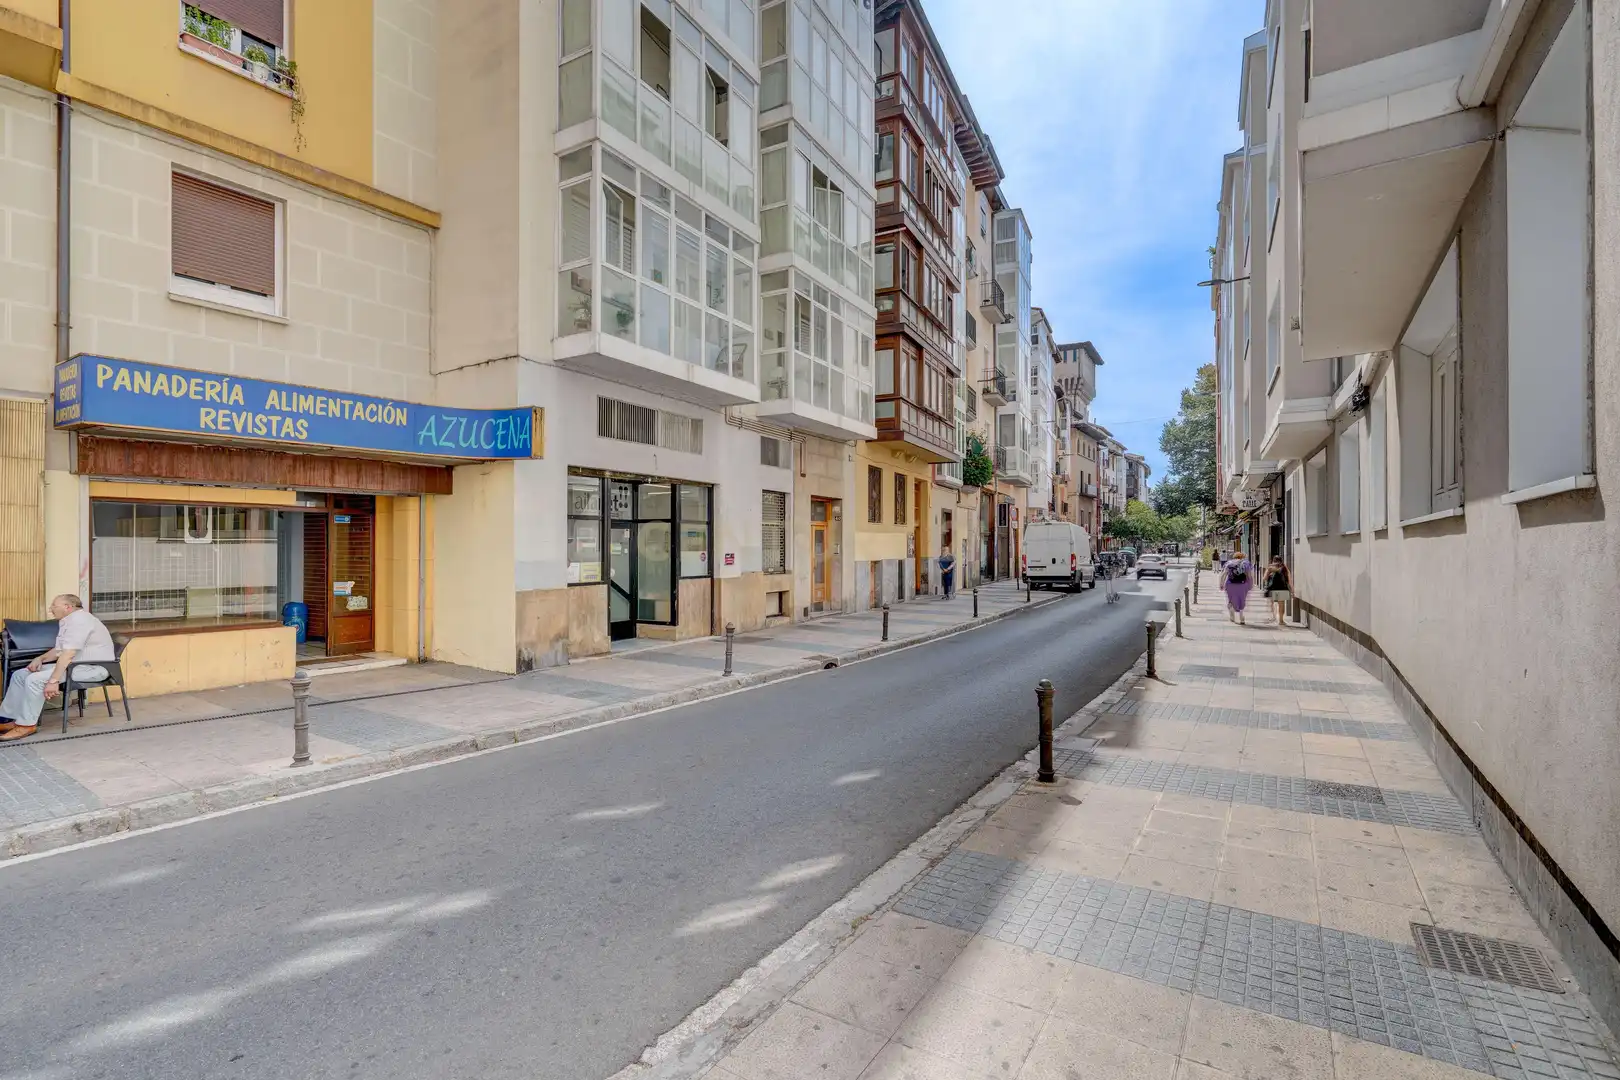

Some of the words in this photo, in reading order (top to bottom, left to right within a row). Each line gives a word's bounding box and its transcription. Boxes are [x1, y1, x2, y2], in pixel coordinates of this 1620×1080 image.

[96, 363, 245, 406] PANADERÍA
[265, 389, 408, 426] ALIMENTACIÓN
[200, 407, 309, 440] REVISTAS
[418, 414, 531, 449] AZUCENA
